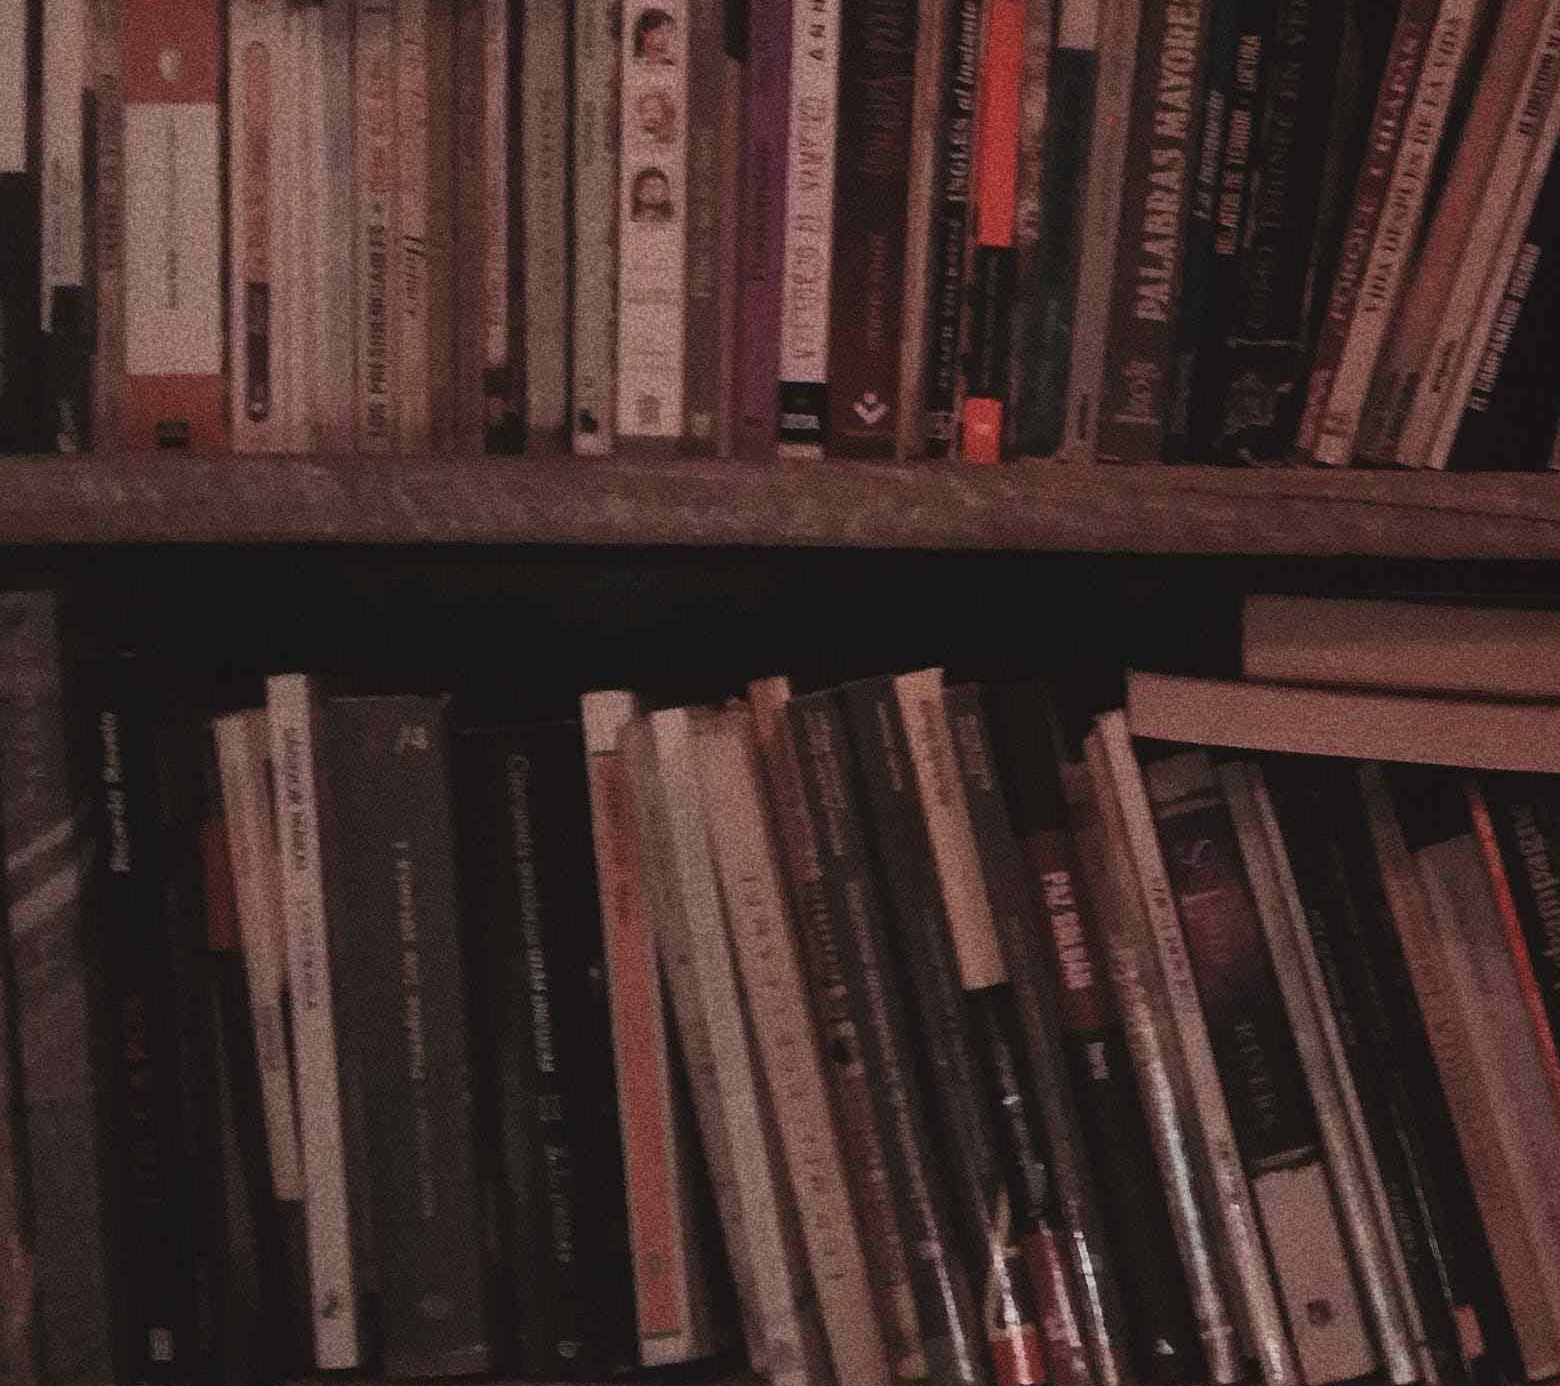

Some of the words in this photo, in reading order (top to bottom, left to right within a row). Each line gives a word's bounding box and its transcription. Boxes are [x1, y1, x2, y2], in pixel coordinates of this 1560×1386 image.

[1232, 34, 1263, 92] LOCURA
[945, 116, 974, 203] INGLES
[1362, 262, 1395, 314] VIDA
[1426, 15, 1461, 69] VIDA
[1134, 148, 1189, 321] PALABRAS
[1042, 871, 1074, 907] PAZ
